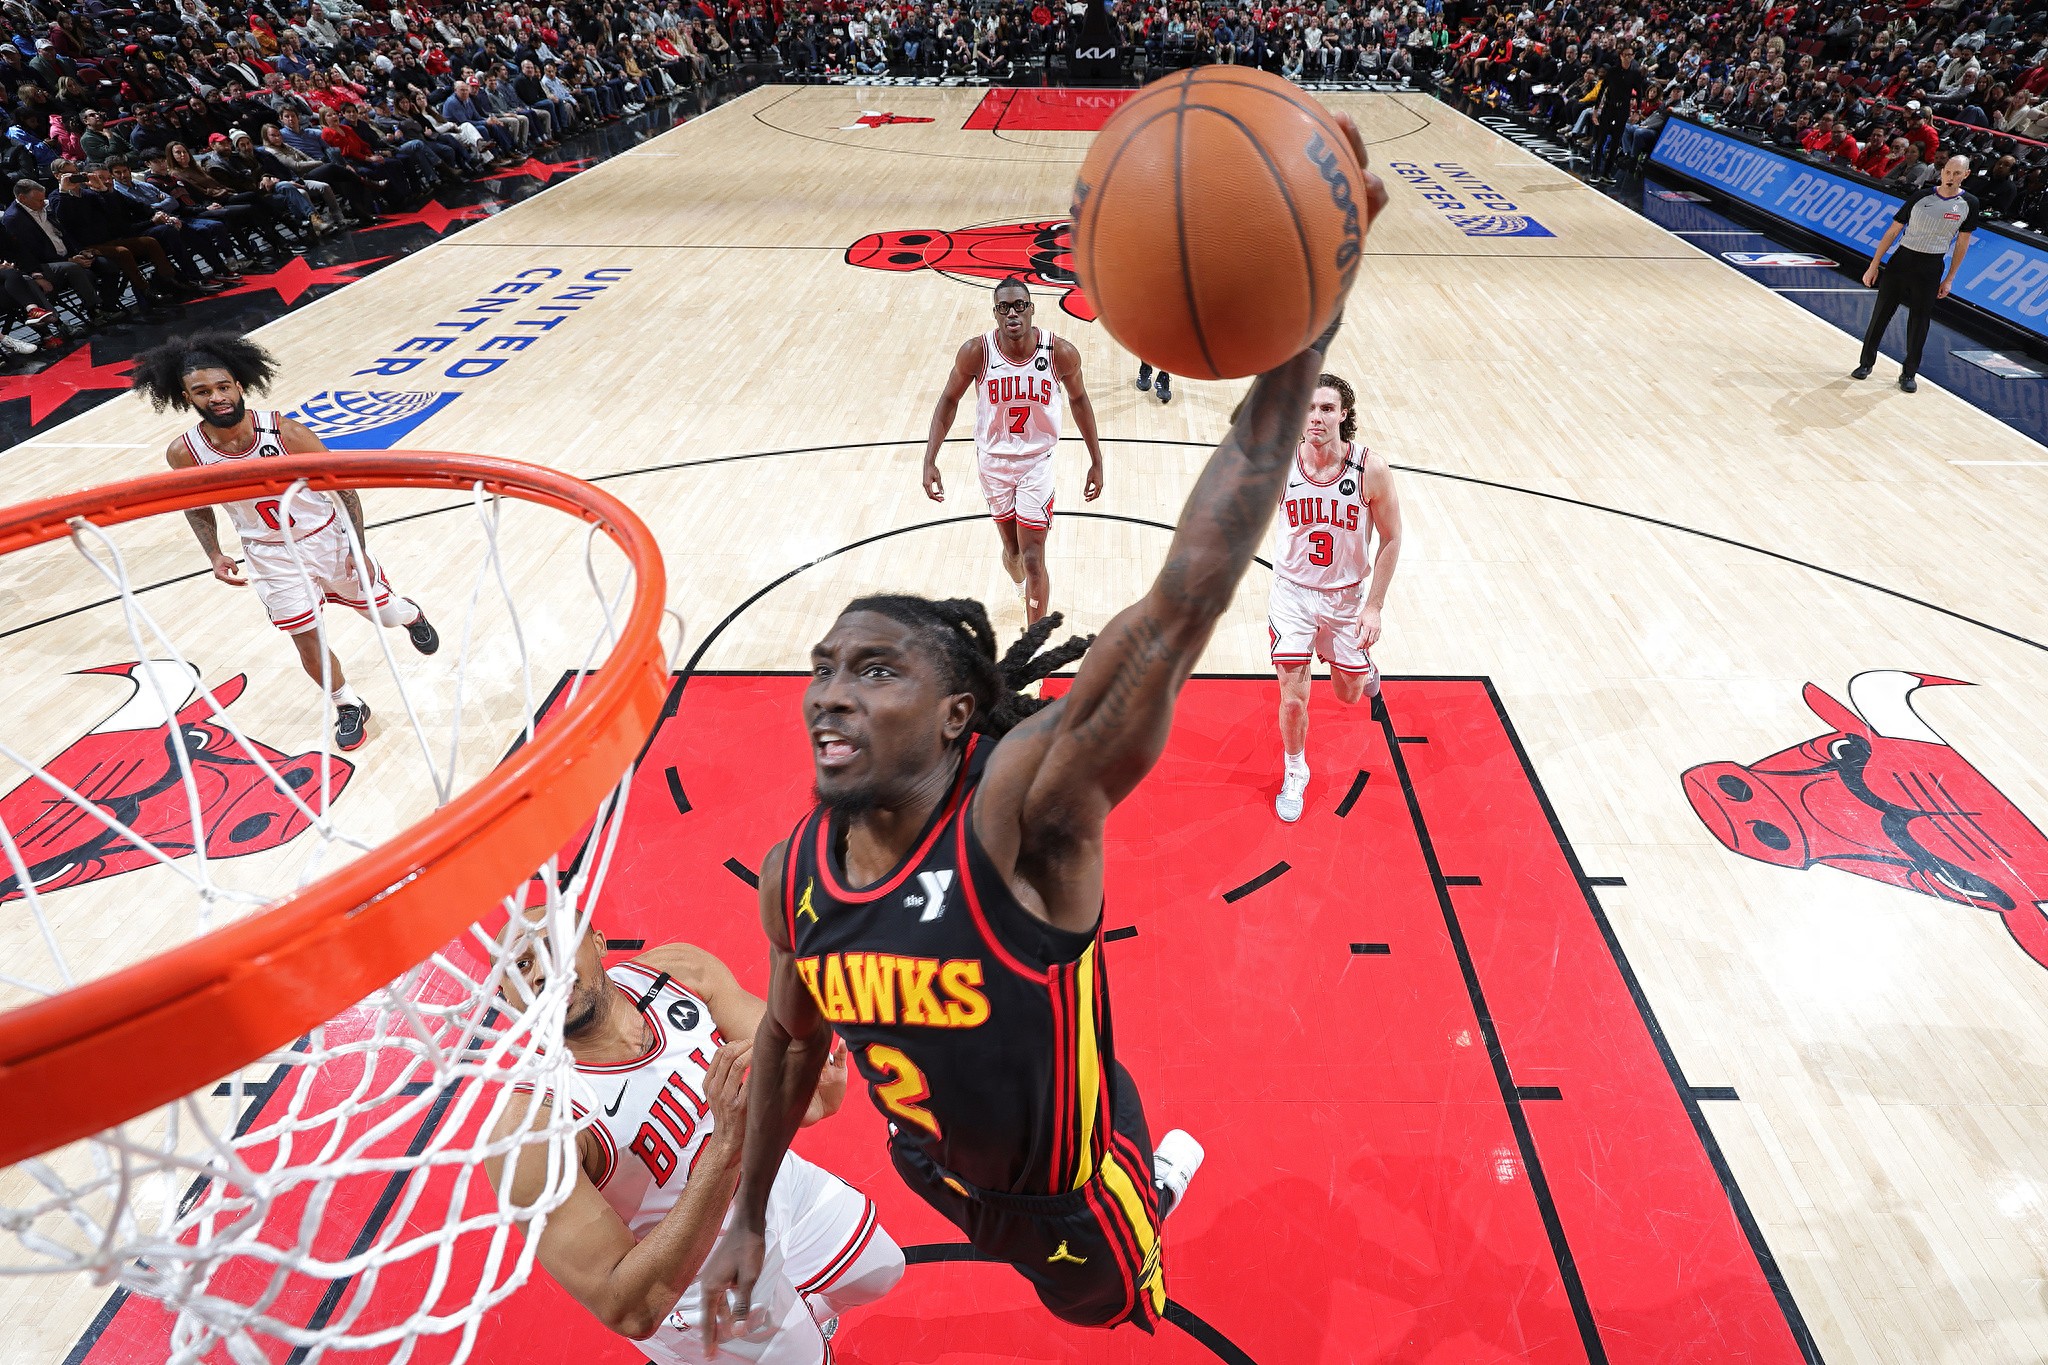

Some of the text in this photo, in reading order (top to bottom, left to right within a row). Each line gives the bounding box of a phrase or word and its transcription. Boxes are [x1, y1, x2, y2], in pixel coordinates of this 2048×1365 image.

[1655, 124, 1786, 198] PROGRESSIVE
[1389, 162, 1466, 210] CENTER
[1434, 162, 1518, 211] UNITED
[1965, 249, 2048, 322] PRO
[350, 267, 562, 376] CENTER
[444, 268, 633, 378] UNITED
[987, 376, 1052, 405] BULLS
[1009, 406, 1030, 433] 7
[255, 500, 296, 531] 0
[1286, 498, 1360, 531] BULLS
[1308, 531, 1334, 567] 3
[903, 894, 926, 908] the
[795, 952, 991, 1029] HAWKS
[629, 1028, 727, 1189] BUL
[865, 1043, 942, 1142] 2
